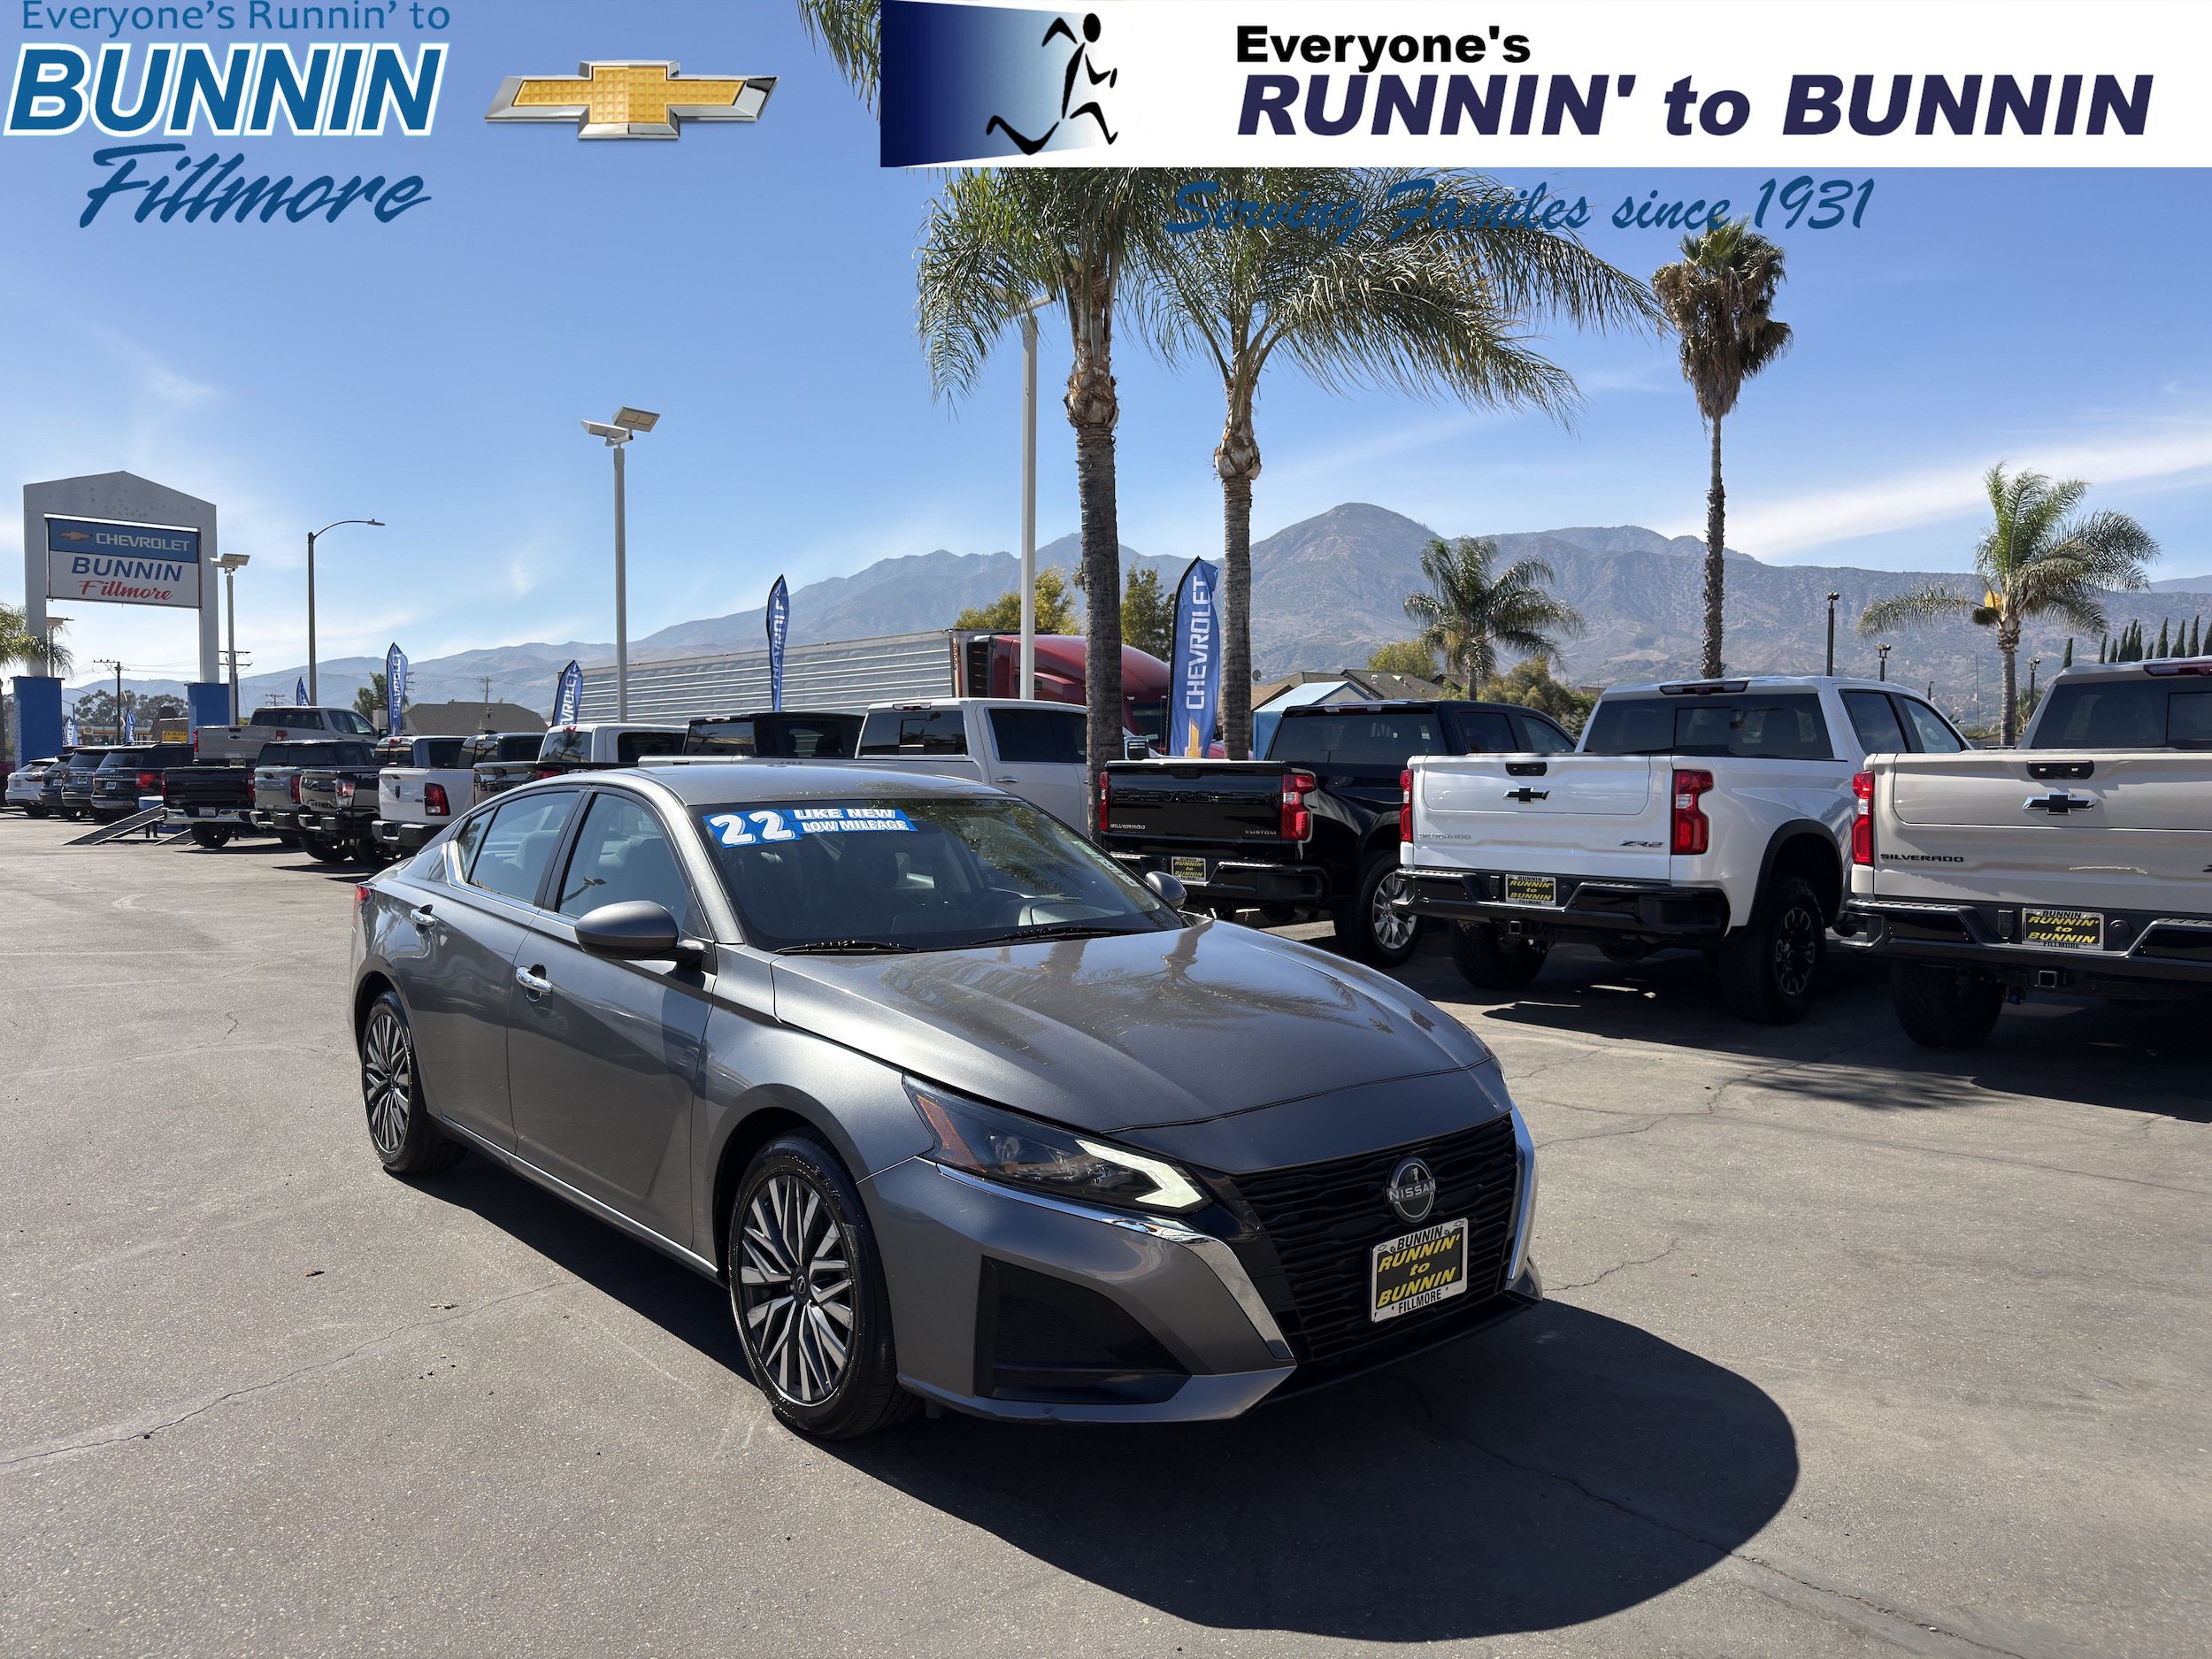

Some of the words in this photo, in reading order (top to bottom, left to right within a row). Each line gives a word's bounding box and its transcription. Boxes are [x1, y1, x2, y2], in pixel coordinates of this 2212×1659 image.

[96, 533, 189, 552] CHEVROLET
[72, 557, 182, 581] BUNNIN
[78, 580, 173, 601] Fillmore
[1186, 576, 1211, 710] CHEVROLET
[794, 809, 841, 819] LIKE
[849, 809, 895, 819] NEW
[710, 810, 795, 845] 22
[802, 821, 839, 833] LOW
[841, 820, 910, 831] MILEAGE
[1880, 854, 1964, 863] SILVERADO
[1509, 892, 1551, 901] BUNNIN
[2028, 917, 2099, 926] RUNNIN'
[2027, 932, 2095, 943] BUNNIN
[1389, 1179, 1436, 1202] NISSAN
[1397, 1225, 1443, 1250] BUNNIN
[1378, 1233, 1460, 1272] RUNNIN'
[1409, 1262, 1431, 1276] to
[1377, 1266, 1456, 1308] BUNNIN
[1398, 1289, 1441, 1314] FILLMORE
